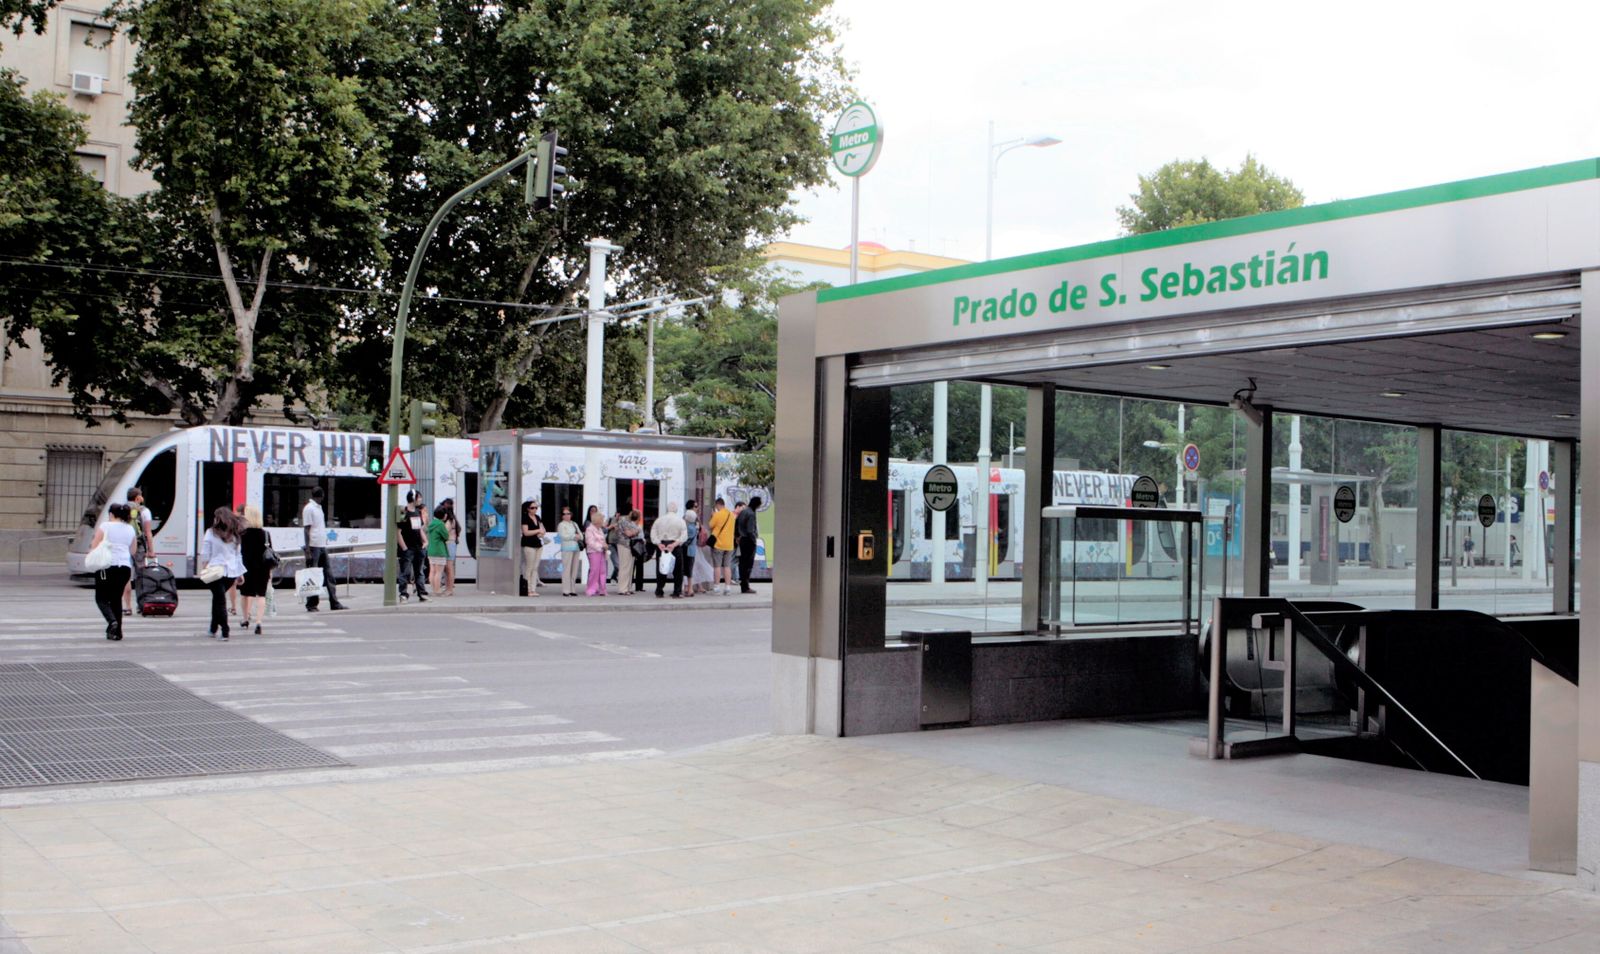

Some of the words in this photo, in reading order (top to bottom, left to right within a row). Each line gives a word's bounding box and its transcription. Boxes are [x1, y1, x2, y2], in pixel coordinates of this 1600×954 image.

[839, 131, 869, 149] Metro
[952, 287, 1037, 326] Prado
[1048, 280, 1088, 314] de
[1099, 273, 1127, 308] S.
[1139, 242, 1329, 302] Sebastián
[209, 428, 307, 465] NEVER
[319, 433, 382, 468] HID
[618, 454, 648, 465] rare
[928, 483, 953, 493] Metro
[1053, 473, 1102, 498] NEVER
[1107, 475, 1136, 500] HID
[1135, 493, 1155, 501] Metro
